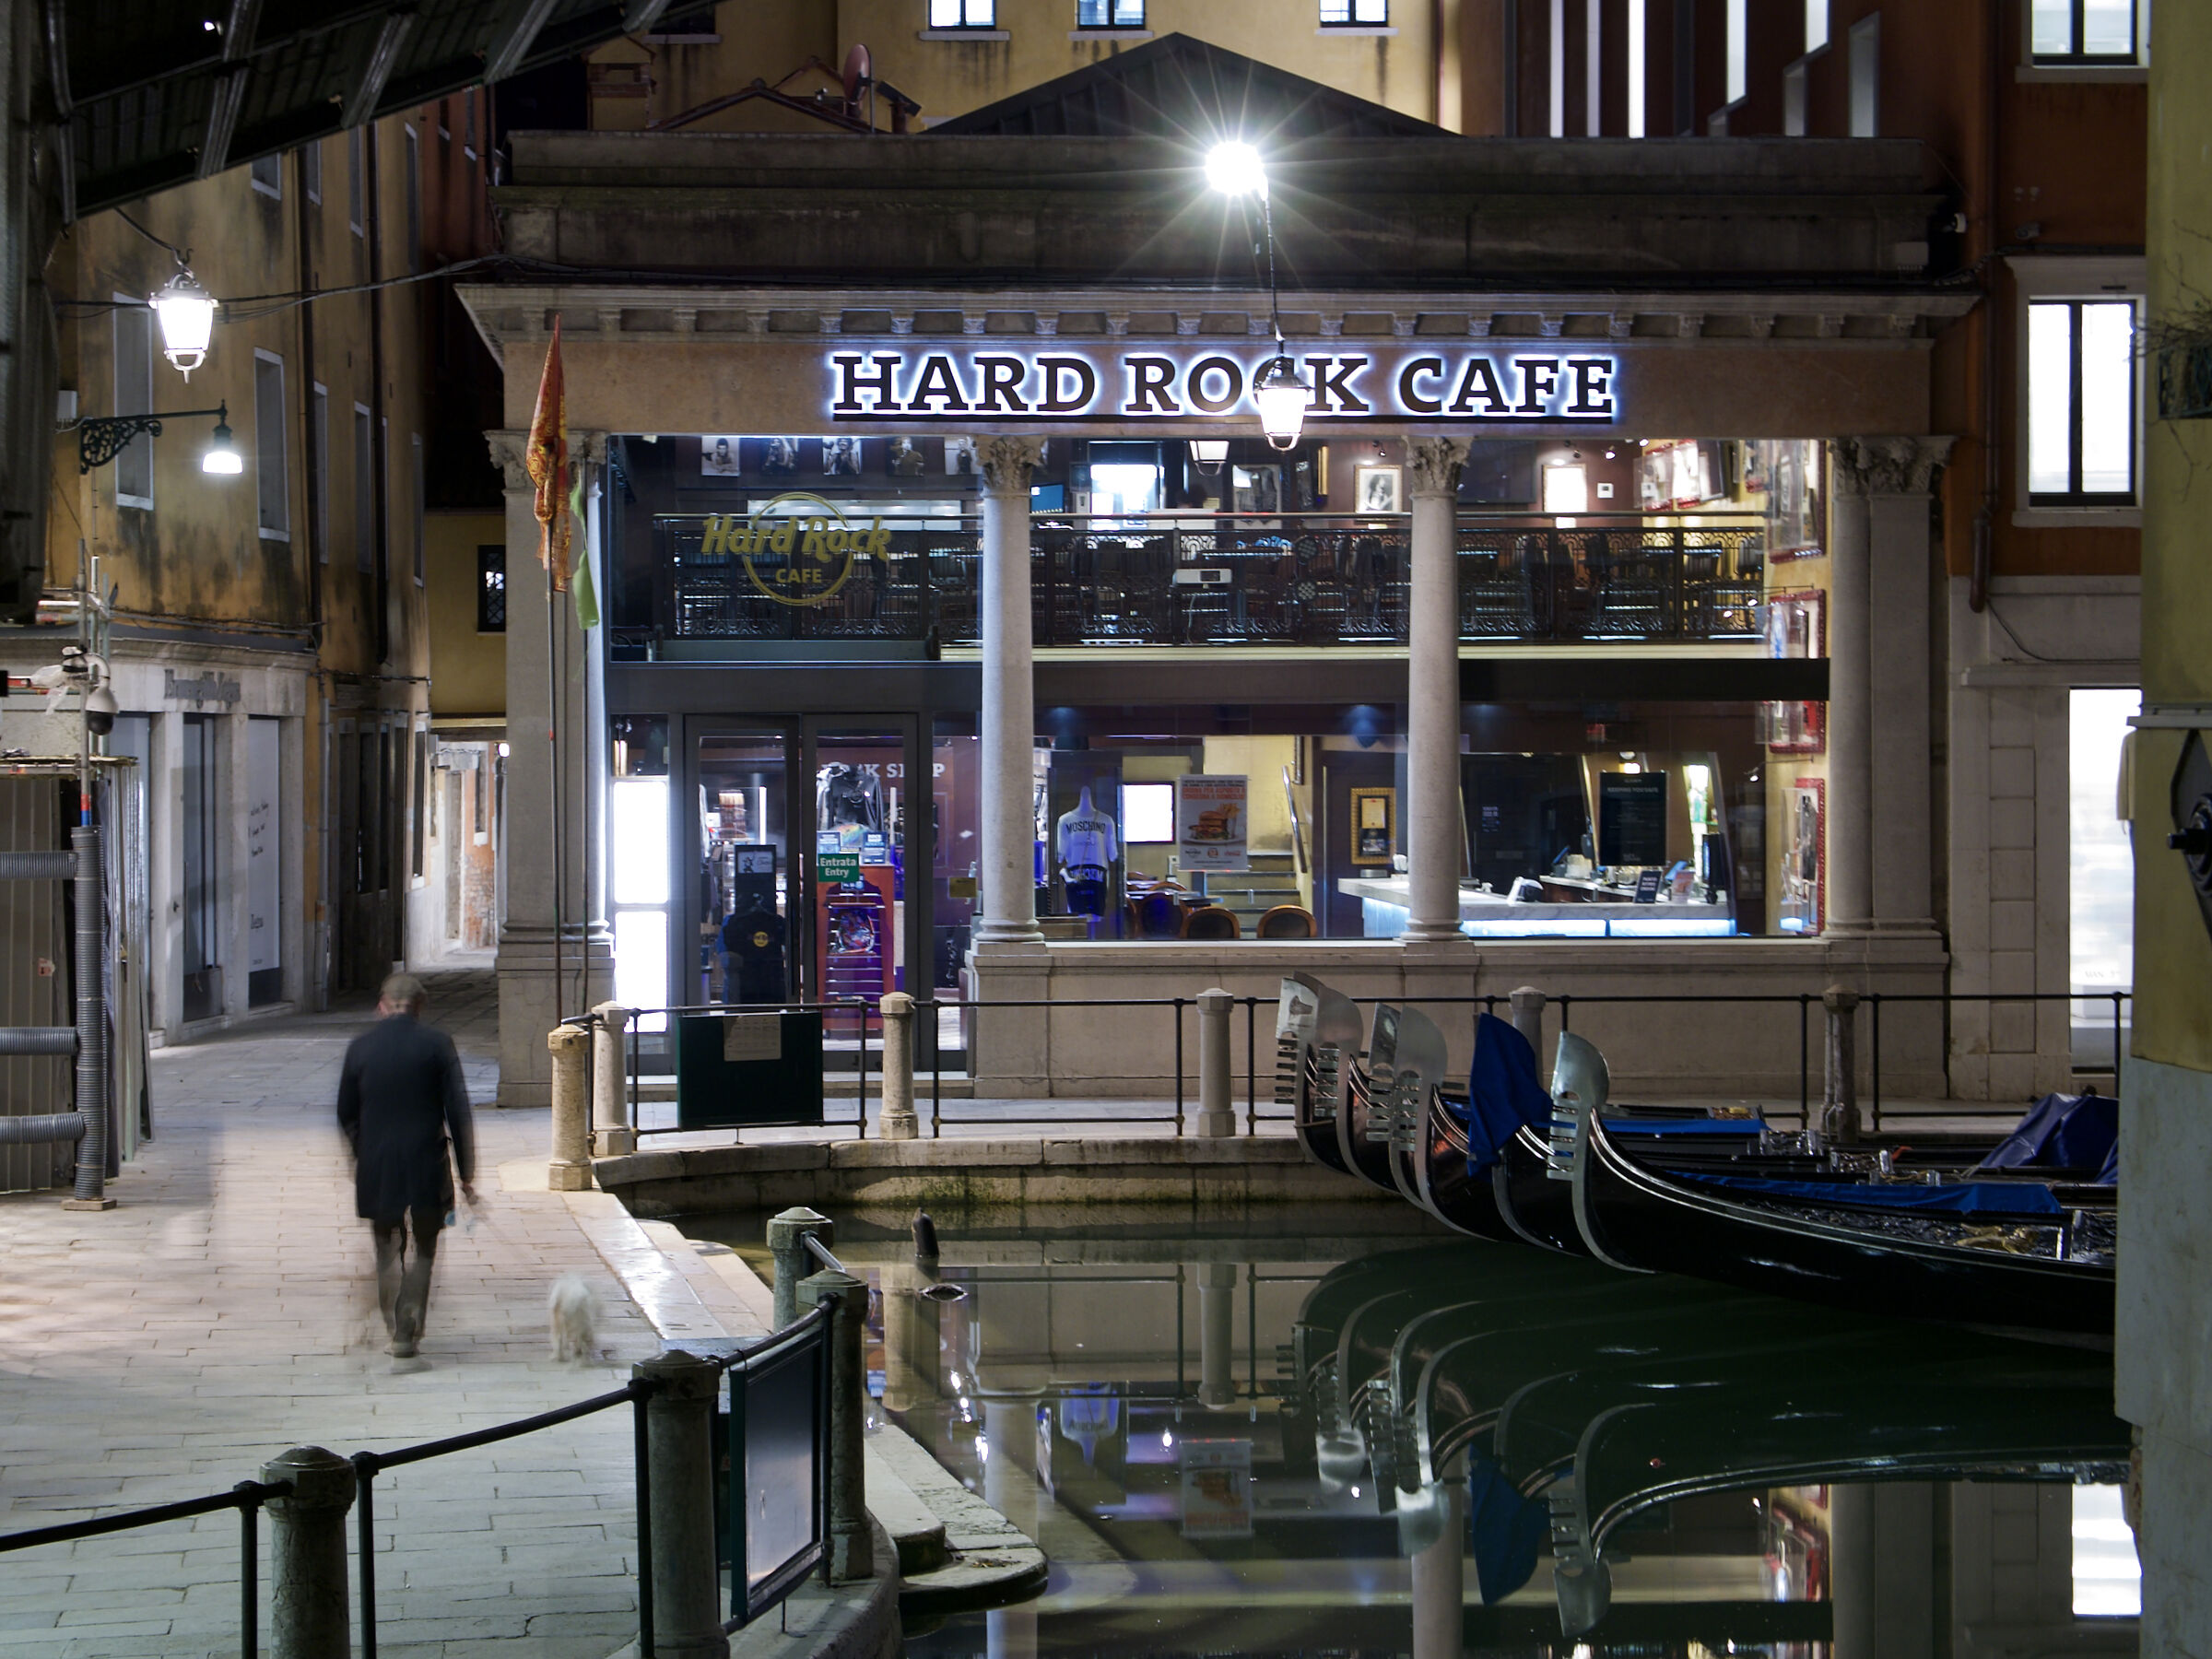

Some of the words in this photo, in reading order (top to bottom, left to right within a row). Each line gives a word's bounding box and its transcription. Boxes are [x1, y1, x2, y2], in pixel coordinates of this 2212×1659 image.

[833, 356, 1095, 412] HARD
[1399, 357, 1612, 414] CAFE
[700, 515, 798, 555] Hard
[802, 515, 892, 563] Rock
[775, 568, 822, 583] CAFE
[886, 763, 946, 778] SP
[1065, 820, 1106, 834] MOSCHINO
[819, 857, 856, 866] Entrata
[825, 867, 850, 878] Entry
